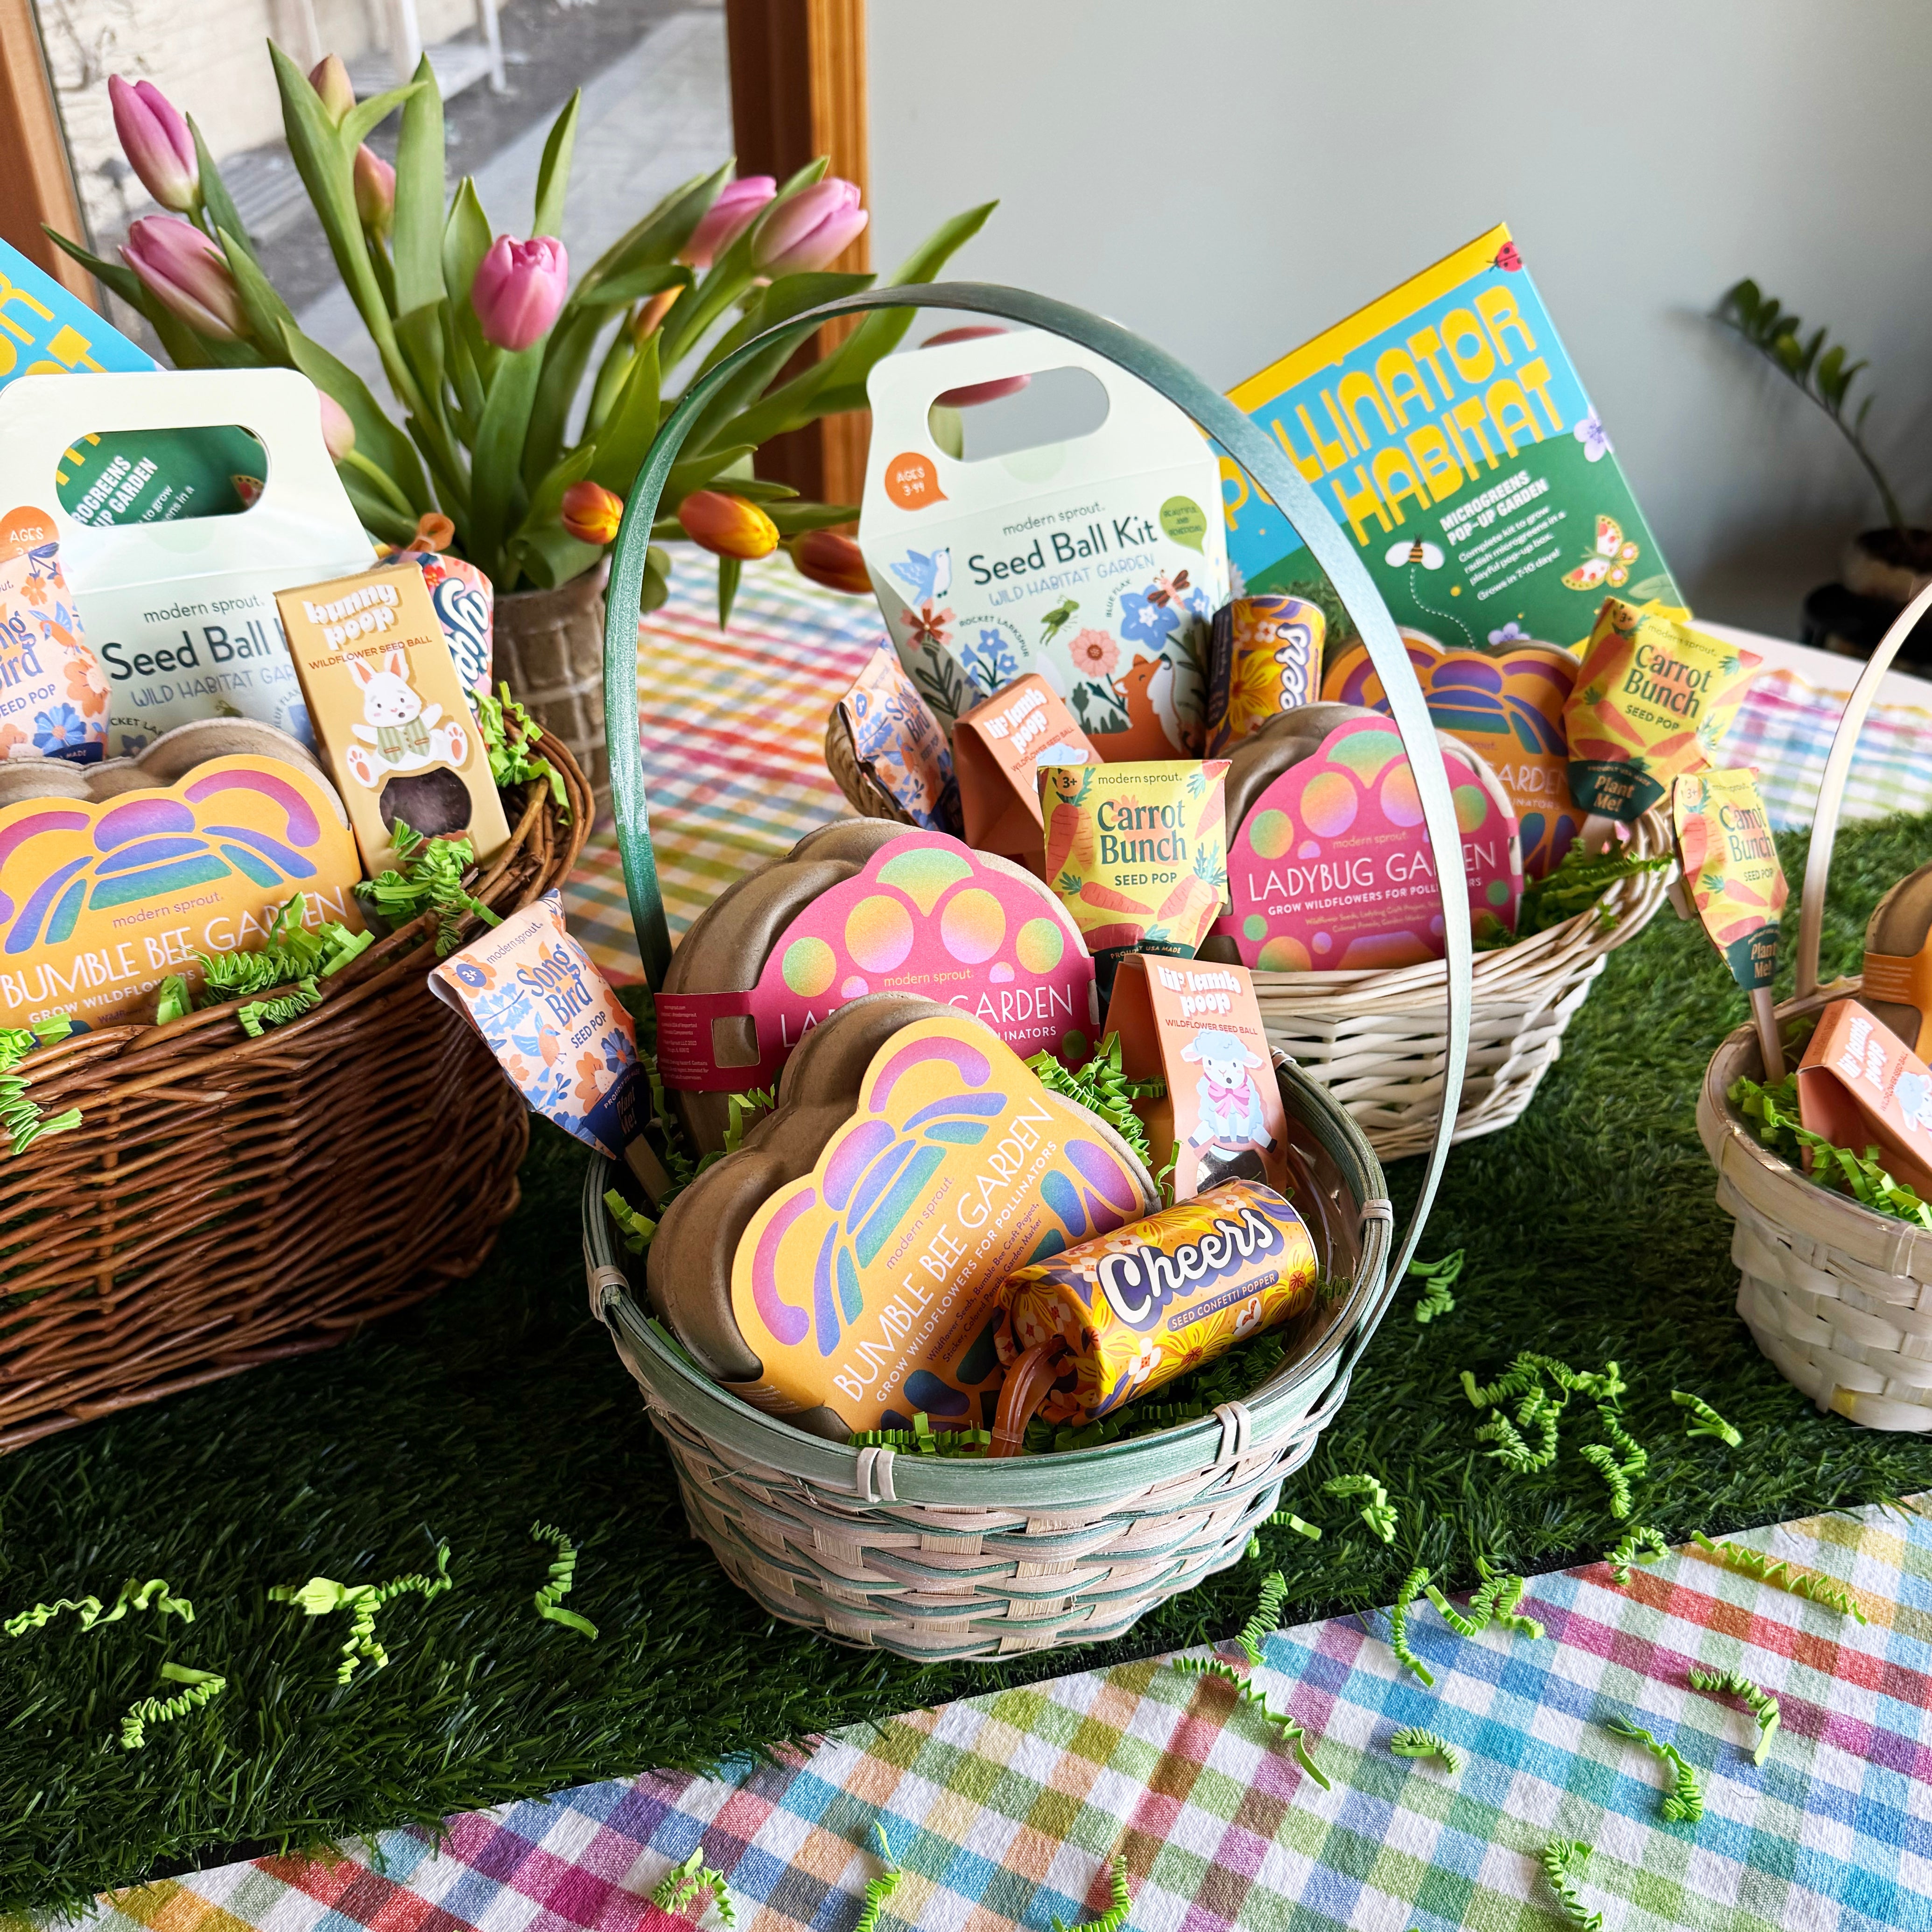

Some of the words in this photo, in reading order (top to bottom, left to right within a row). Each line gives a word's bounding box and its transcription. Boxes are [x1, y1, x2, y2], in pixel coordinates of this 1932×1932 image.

[1218, 285, 1537, 532] PLLINATOR
[1331, 357, 1564, 548] HABITAT
[70, 456, 131, 523] ROGREENS
[109, 457, 158, 513] GARDEN
[152, 485, 173, 512] grow
[1440, 469, 1531, 532] MICROGREENS
[1003, 515, 1056, 536] modern
[1447, 508, 1496, 546] POP-UP
[1496, 477, 1550, 517] GARDEN
[1547, 515, 1559, 525] in
[10, 527, 44, 543] AGES
[969, 539, 1046, 585] Seed
[1050, 523, 1108, 563] Ball
[1113, 515, 1158, 548] Kit
[1459, 533, 1503, 562] Complete
[1502, 525, 1517, 537] kit
[1515, 519, 1526, 529] to
[1526, 506, 1551, 526] grow
[989, 586, 1024, 606] WILD
[1027, 567, 1091, 595] HABITAT
[1097, 553, 1156, 578] GARDEN
[144, 601, 209, 623] modern
[302, 584, 397, 624] bunny
[959, 615, 994, 627] ROCKET
[1621, 613, 1632, 622] 3+
[323, 606, 395, 651] poop
[1648, 625, 1682, 642] modern
[102, 631, 199, 680] Seed
[204, 620, 272, 663] Ball
[309, 648, 377, 670] WILDFLOWER
[380, 641, 405, 653] SEED
[407, 636, 432, 647] BALL
[1275, 624, 1308, 710] eers
[0, 646, 44, 690] ird
[1635, 645, 1712, 693] Carrot
[0, 698, 27, 717] EED
[28, 684, 56, 704] POP
[131, 686, 174, 707] WILD
[177, 671, 253, 698] HABITAT
[260, 664, 297, 684] GAR
[1623, 668, 1700, 718] Bunch
[111, 718, 141, 726] CKET
[1003, 688, 1047, 728] lamb
[1625, 704, 1654, 722] SEED
[1656, 717, 1679, 731] POP
[1010, 710, 1047, 754] poop
[1011, 744, 1047, 772] WILDFLOWER
[1047, 736, 1061, 746] SEED
[1060, 727, 1075, 738] BALL
[1062, 776, 1077, 788] 3+
[1098, 773, 1141, 785] modern
[1594, 775, 1636, 798] Plant
[1687, 789, 1697, 798] 3+
[1097, 800, 1185, 832] Carrot
[1594, 793, 1623, 812] Me!
[1720, 804, 1766, 831] Carrot
[1101, 830, 1187, 864] Bunch
[1333, 836, 1373, 849] modern
[1728, 830, 1775, 862] Bunch
[1115, 873, 1148, 886] SEED
[1152, 872, 1177, 884] POP
[1249, 857, 1374, 901] LADYBUG
[1386, 841, 1496, 882] GAEN
[1744, 870, 1760, 881] SEED
[1761, 867, 1773, 878] POP
[112, 909, 169, 928] modern
[1268, 903, 1301, 915] GROW
[1305, 891, 1382, 910] WILDFLOWERS
[1385, 889, 1406, 899] FOR
[0, 942, 140, 1009] BUMBLE
[144, 927, 198, 970] BEE
[204, 886, 347, 950] GAREN
[486, 940, 517, 964] modern
[1751, 942, 1776, 960] Plant
[462, 969, 477, 982] 3+
[517, 943, 580, 997] Song
[884, 972, 930, 986] modern
[1186, 970, 1241, 994] lamb
[28, 1001, 77, 1024] GROW
[545, 977, 593, 1026] Bird
[1180, 993, 1231, 1017] poop
[571, 1026, 592, 1048] SEED
[590, 1011, 606, 1031] POP
[997, 1026, 1056, 1041] INATORS
[1166, 1019, 1217, 1030] WILDFLOWER
[1845, 1017, 1873, 1063] lamb
[1865, 1040, 1888, 1091] poop
[1894, 1063, 1903, 1075] SEED
[1898, 1051, 1908, 1063] BALL
[1880, 1075, 1898, 1111] WILDFLOWER
[833, 1272, 934, 1402] BUMBLE
[919, 1223, 968, 1282] BEE
[958, 1097, 1054, 1228] GARDEN
[887, 1220, 924, 1270] modern
[877, 1357, 908, 1401] GROW
[906, 1259, 977, 1356] WILDFLOWERS
[975, 1229, 998, 1259] FOR
[995, 1141, 1057, 1229] POLLINATORS
[927, 1321, 958, 1362] Wildflower
[956, 1298, 977, 1320] Seeds,
[973, 1267, 996, 1295] Bumble
[993, 1251, 1005, 1266] Bee
[1004, 1230, 1019, 1250] Craft
[1017, 1203, 1040, 1230] Project,
[1098, 1208, 1274, 1324] Cheers
[943, 1332, 967, 1363] Sticker,
[963, 1302, 985, 1332] Colored
[1004, 1246, 1024, 1272] Garden
[1021, 1218, 1041, 1246] Marker
[1172, 1312, 1195, 1328] SEED
[1197, 1292, 1240, 1316] CONFETTI
[1242, 1274, 1275, 1296] POPPER
